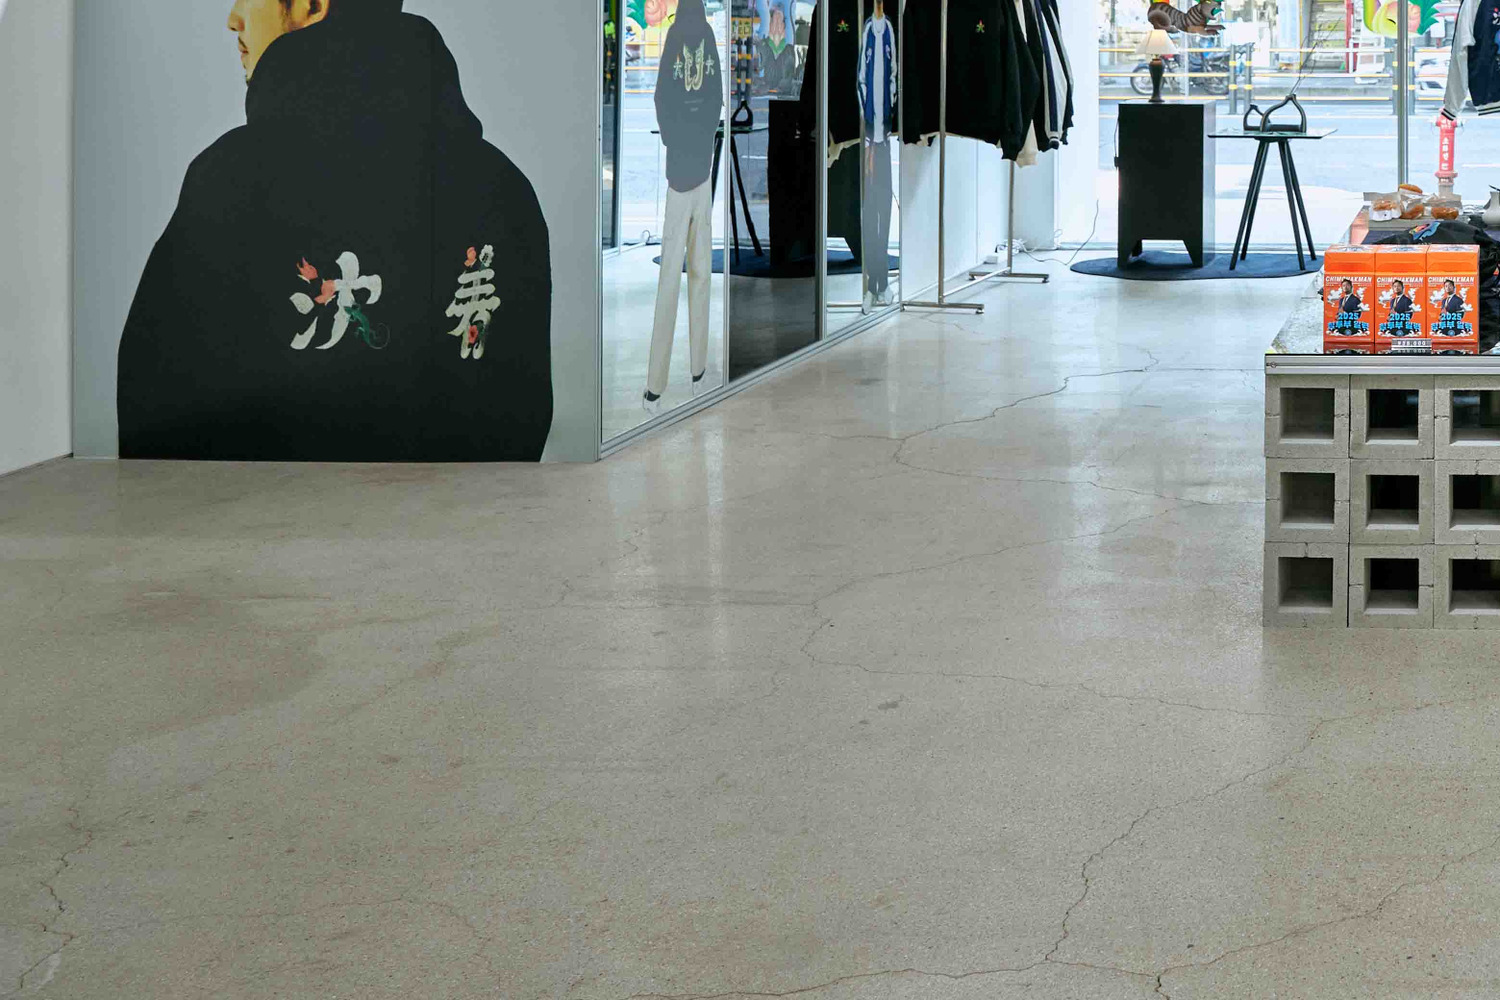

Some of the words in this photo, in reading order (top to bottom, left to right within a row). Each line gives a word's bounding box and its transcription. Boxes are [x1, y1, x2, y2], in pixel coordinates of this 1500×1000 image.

[1338, 312, 1359, 320] 2025
[1389, 313, 1411, 321] 2025
[1441, 313, 1462, 321] 2025
